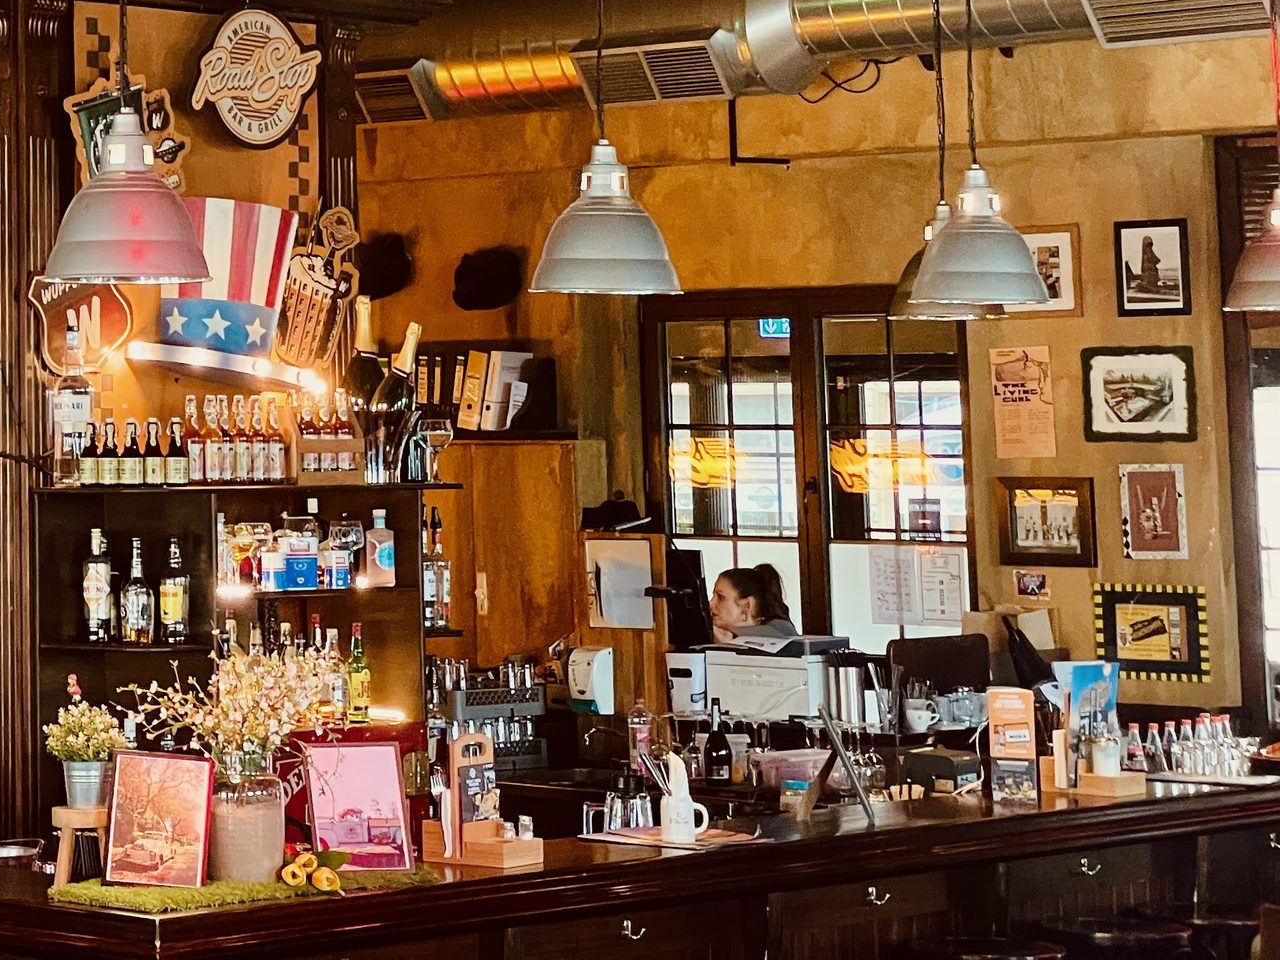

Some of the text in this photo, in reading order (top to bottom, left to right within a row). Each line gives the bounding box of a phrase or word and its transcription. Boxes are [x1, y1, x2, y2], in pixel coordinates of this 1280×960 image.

[226, 20, 272, 44] AMERICAN
[193, 40, 320, 107] Road Stop
[152, 111, 164, 129] W
[227, 104, 283, 134] BAR & GRILL
